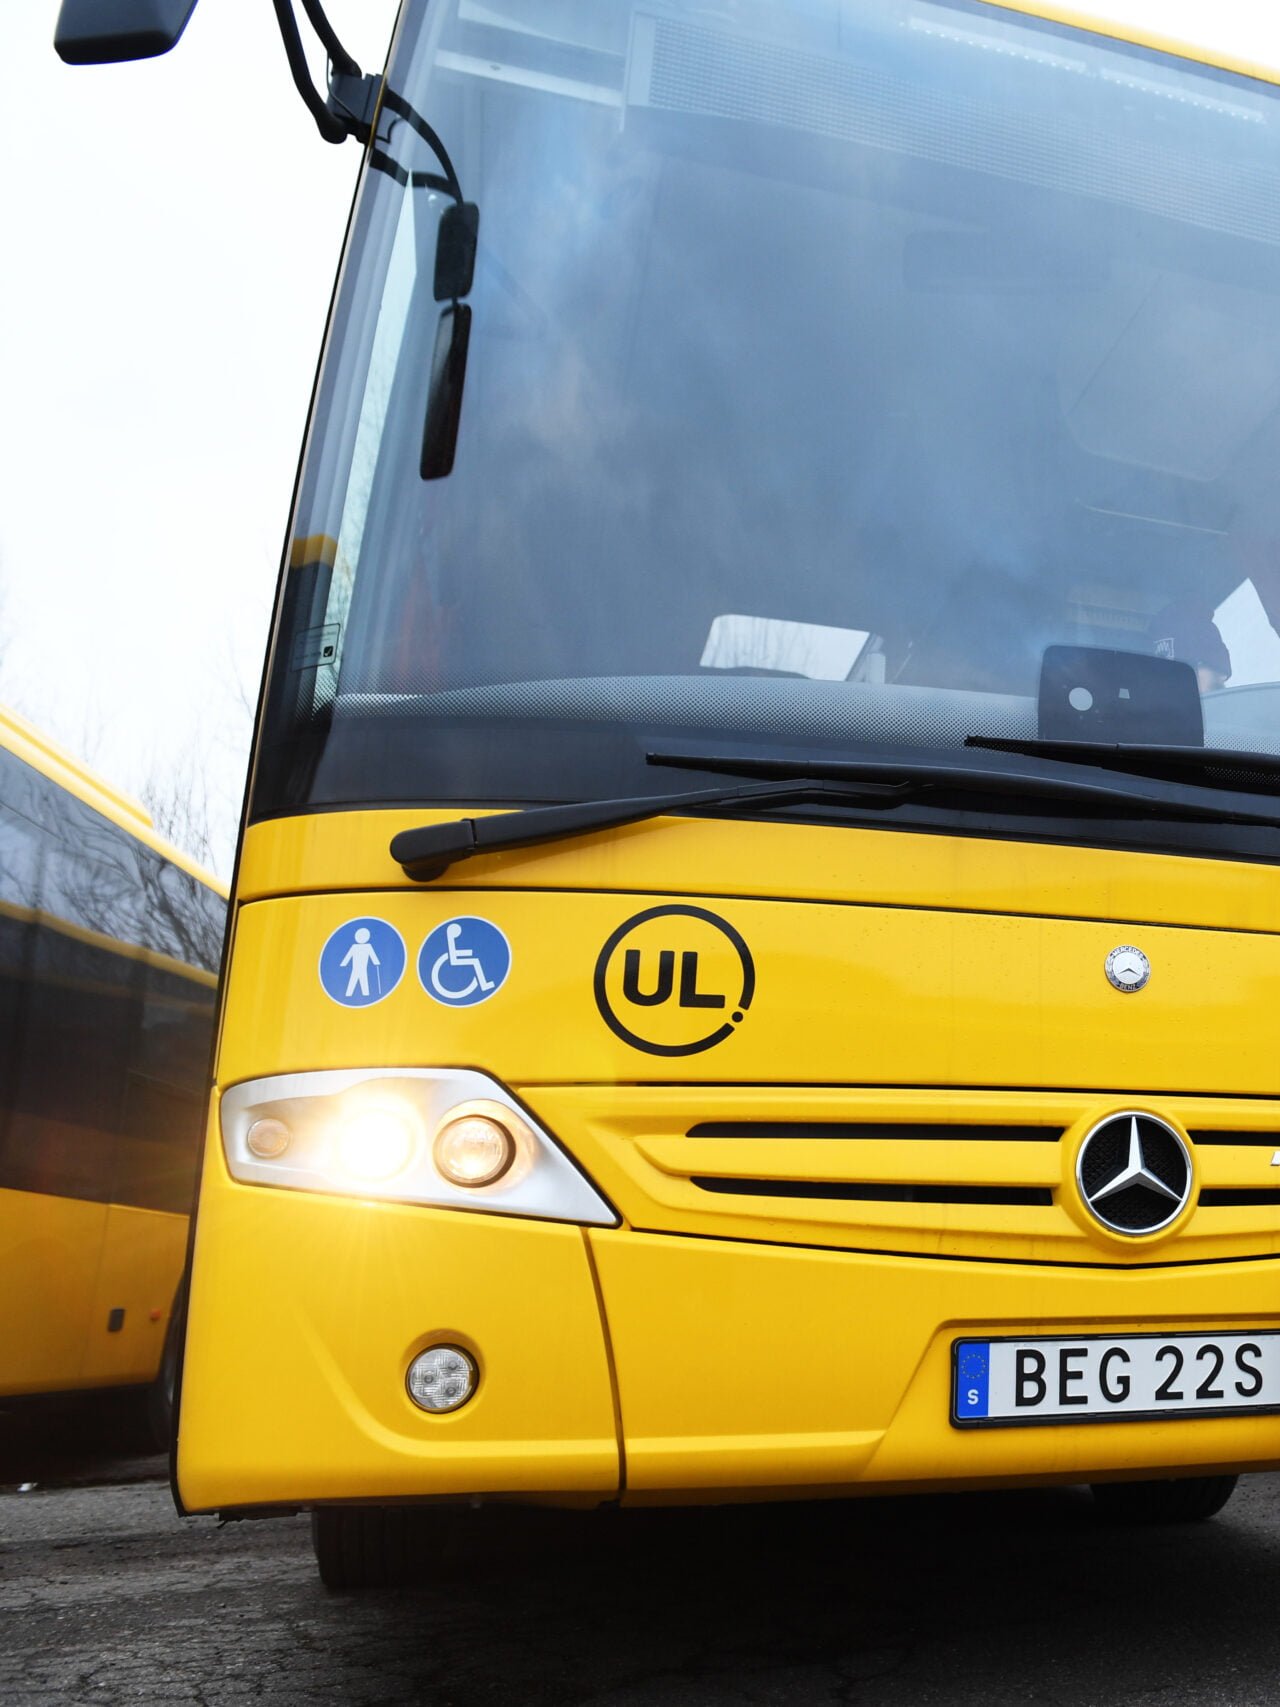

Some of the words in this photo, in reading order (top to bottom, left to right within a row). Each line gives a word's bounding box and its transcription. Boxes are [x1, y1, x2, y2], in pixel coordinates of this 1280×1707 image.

[623, 949, 726, 1009] UL
[967, 1389, 979, 1405] S
[1015, 1347, 1132, 1407] BEG
[1155, 1343, 1264, 1400] 22S
